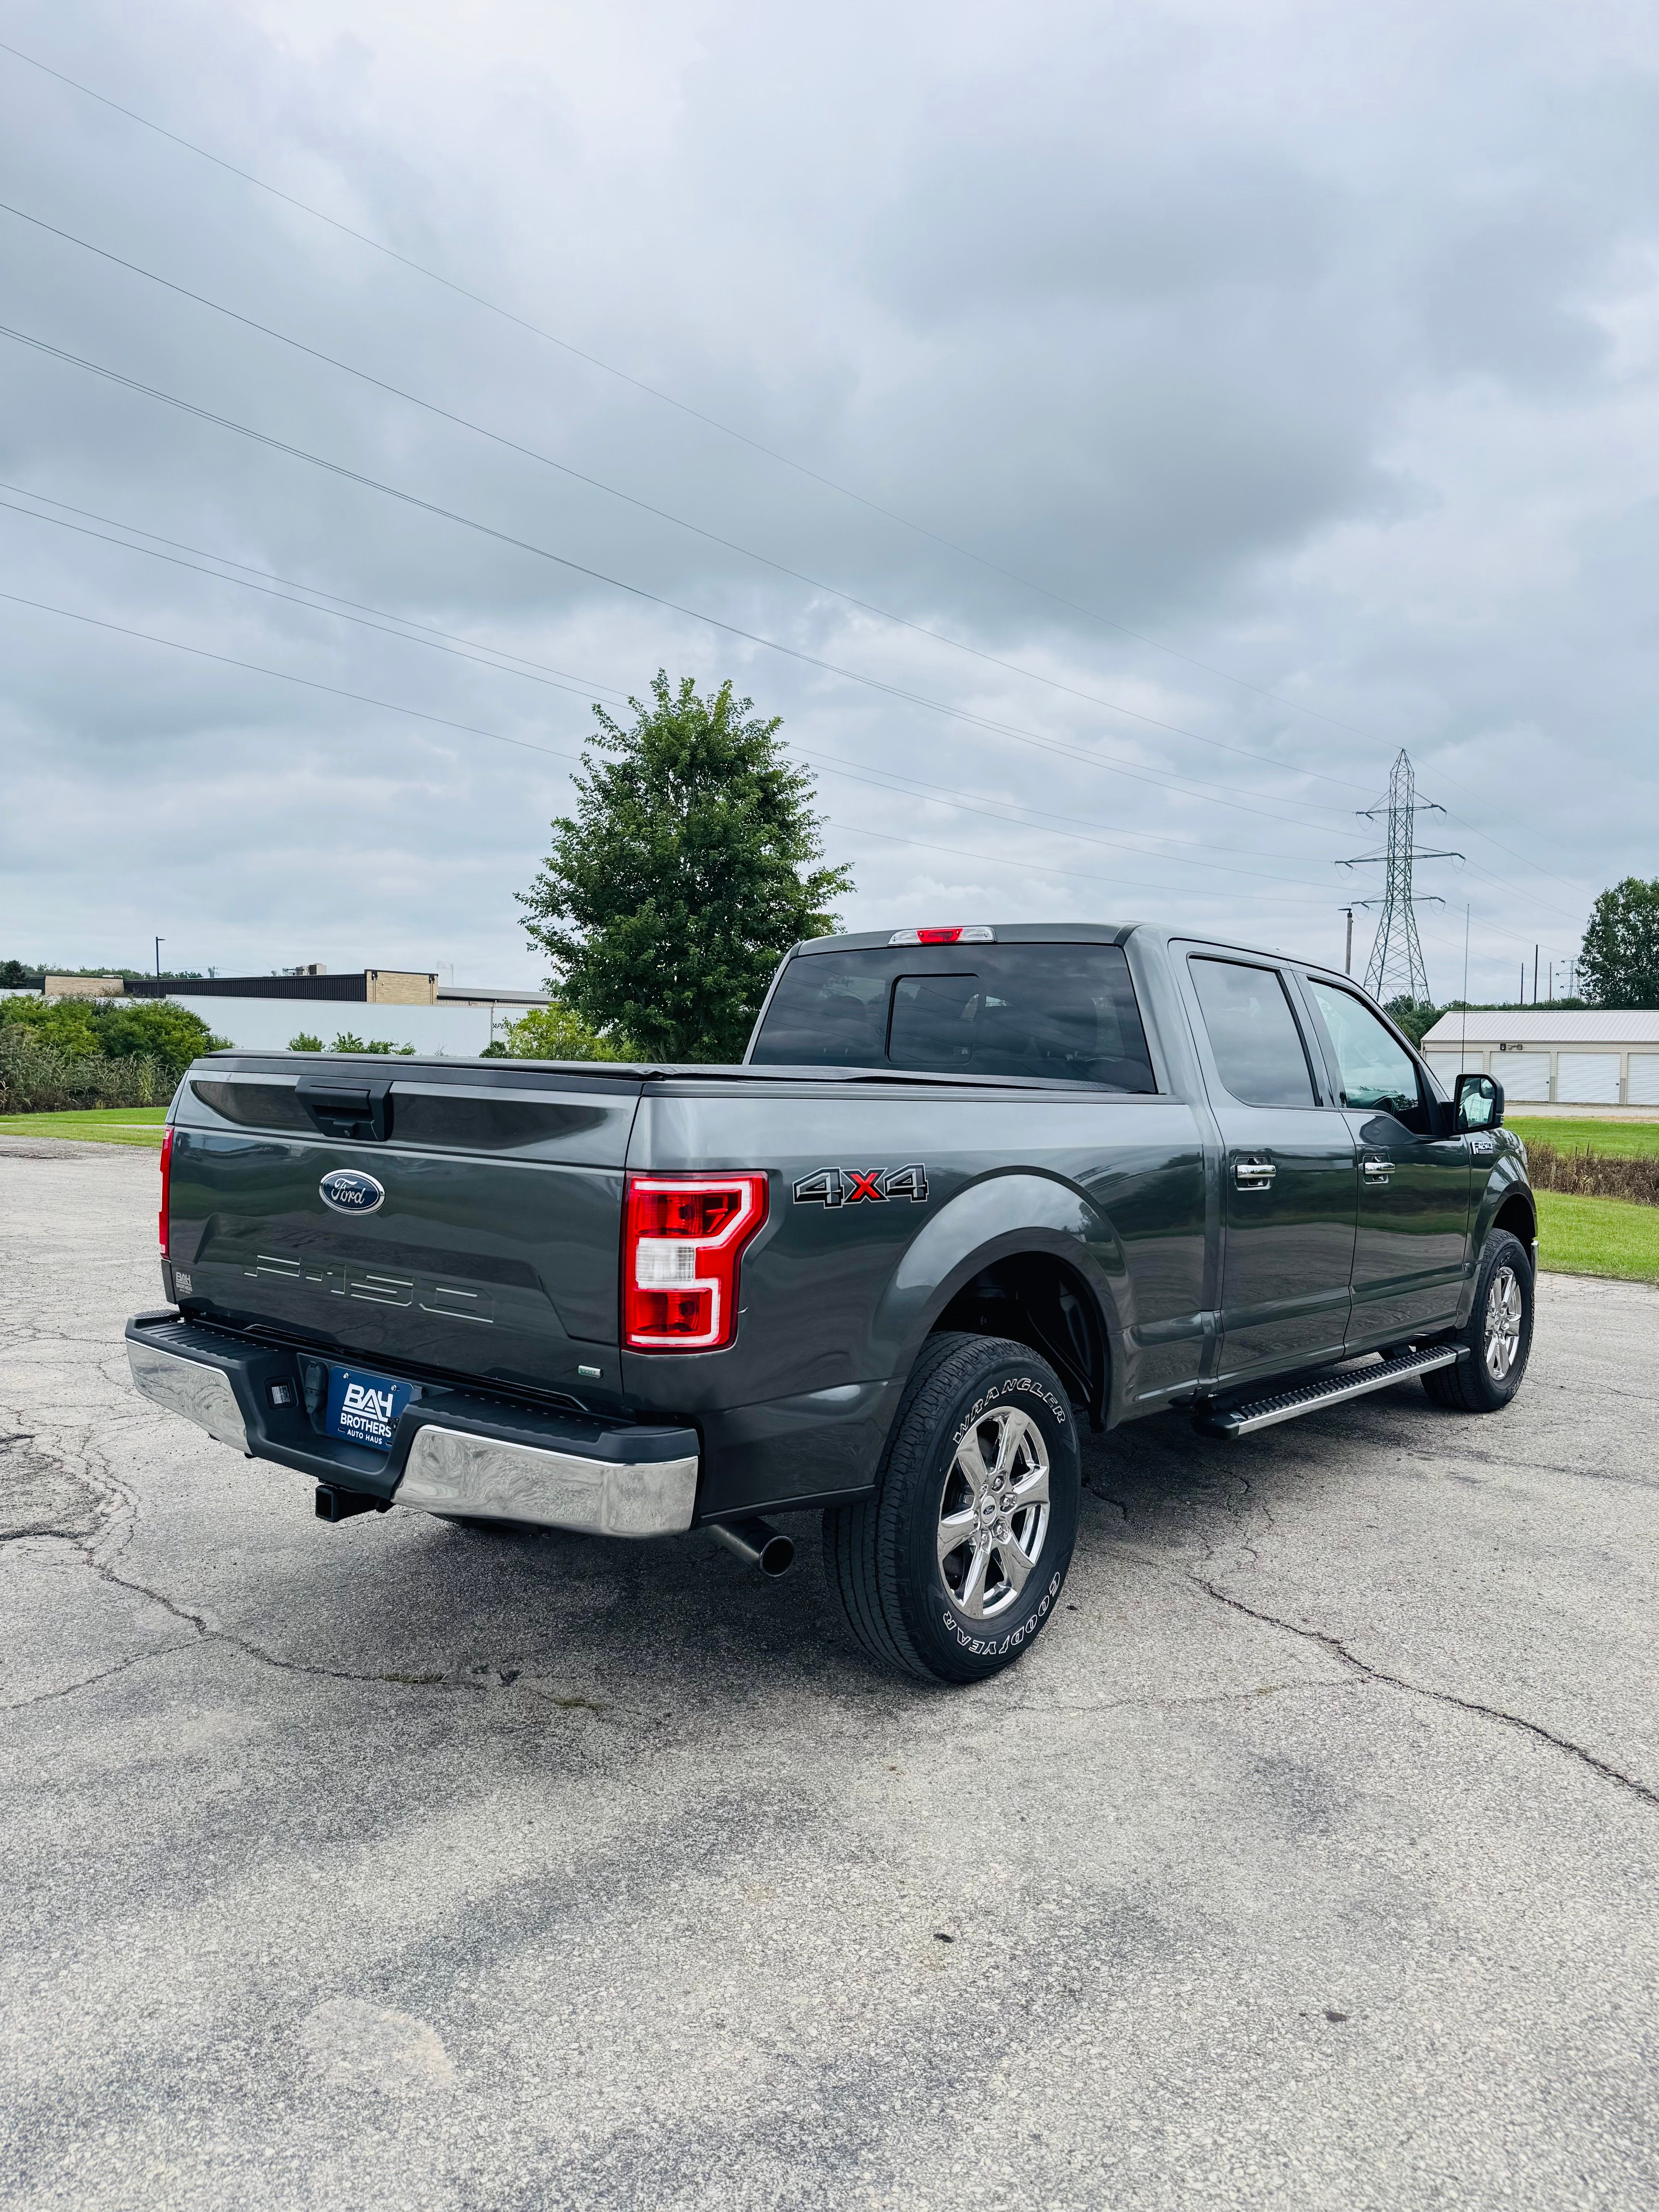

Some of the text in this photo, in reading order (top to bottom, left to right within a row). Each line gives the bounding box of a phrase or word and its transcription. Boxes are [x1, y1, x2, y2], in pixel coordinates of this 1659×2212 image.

[331, 1178, 366, 1204] Ford
[176, 1271, 192, 1286] BAH
[343, 1383, 393, 1423] BAH
[953, 1377, 1065, 1444] WRANGLER
[340, 1412, 392, 1437] BROTHERS
[347, 1429, 382, 1444] AUTO HAUS
[943, 1571, 1060, 1655] GOODYEAR
